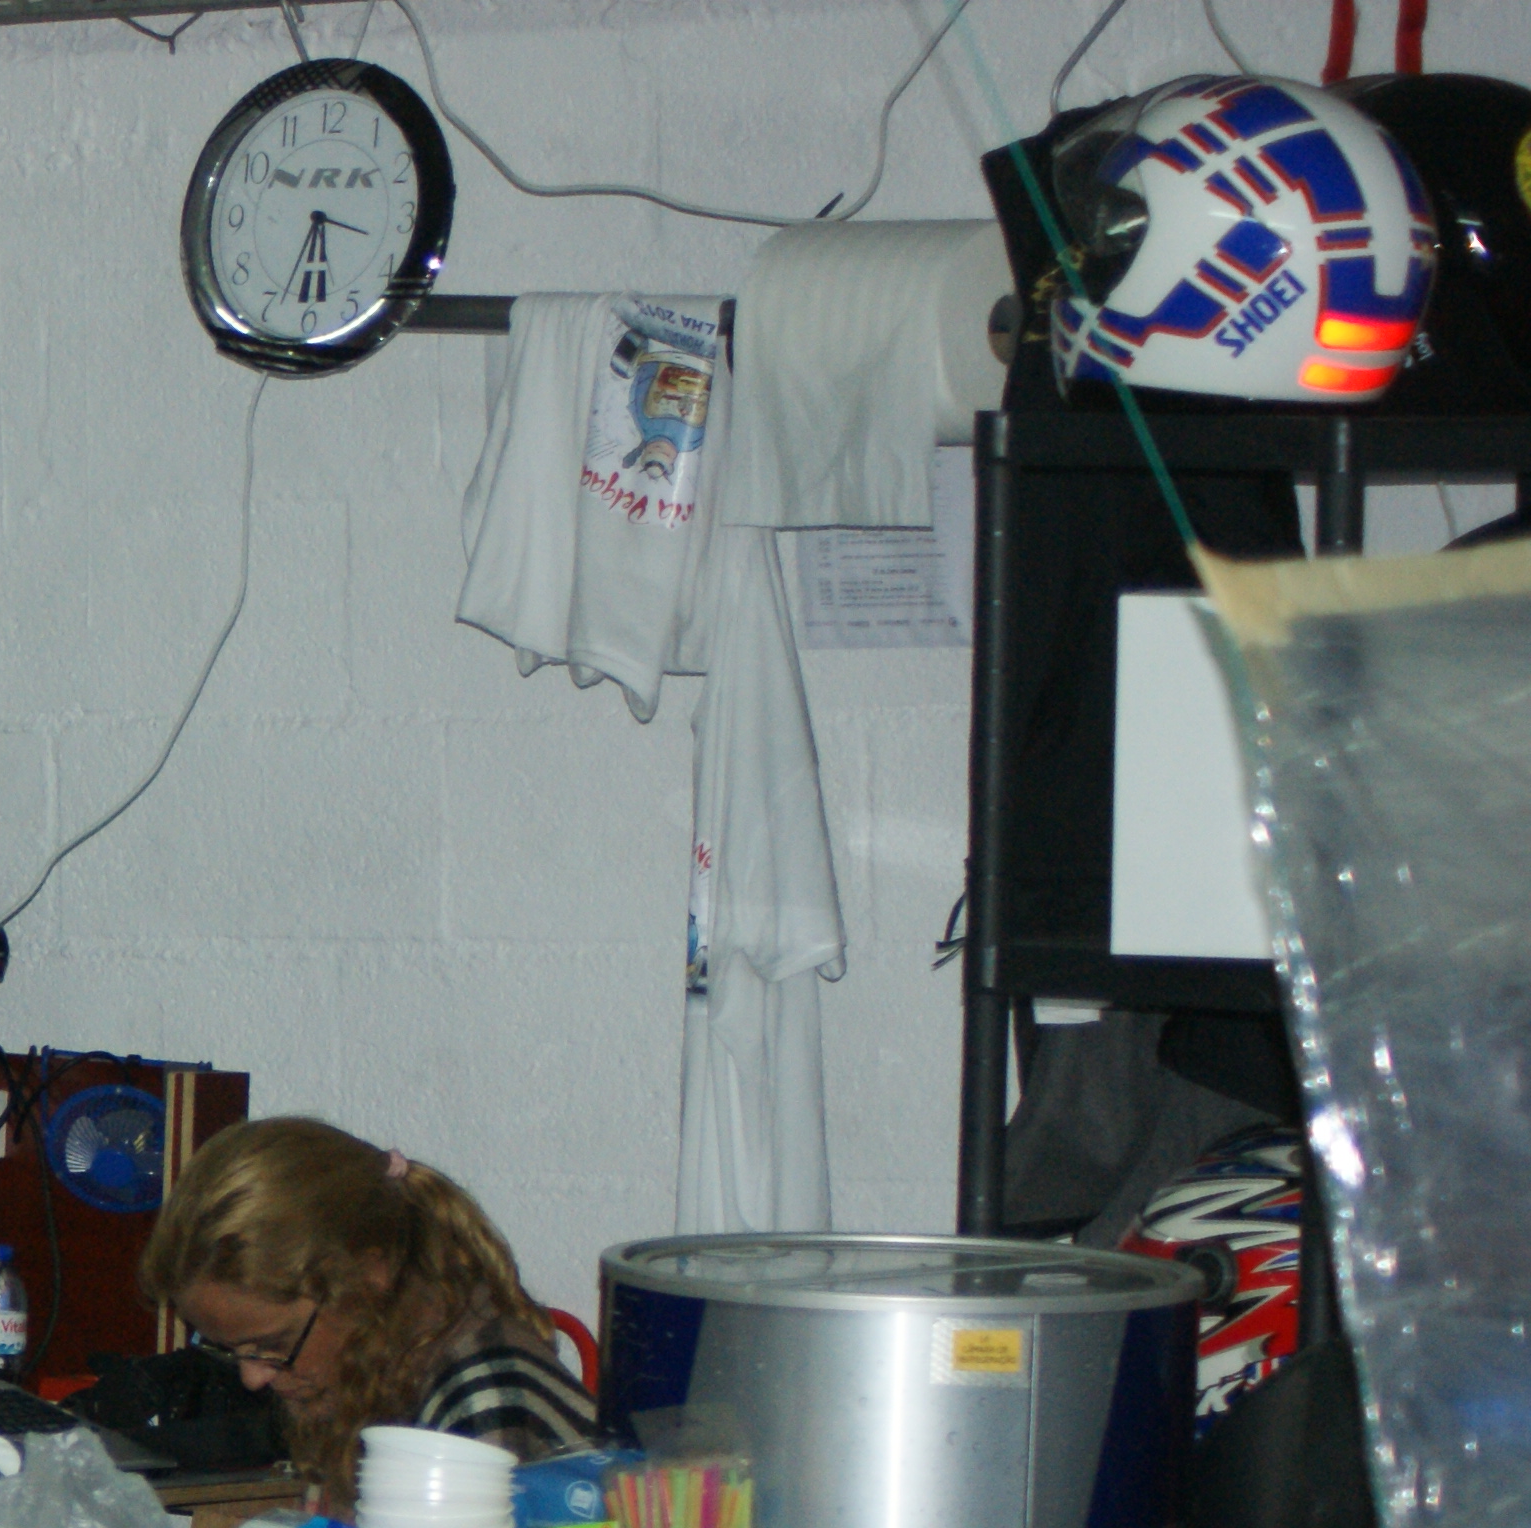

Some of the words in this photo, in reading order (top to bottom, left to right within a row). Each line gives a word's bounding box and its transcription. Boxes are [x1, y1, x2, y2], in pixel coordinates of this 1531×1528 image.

[282, 115, 297, 147] 11
[321, 101, 347, 133] 12
[372, 117, 380, 148] 1
[243, 151, 270, 184] 10
[268, 168, 381, 189] NRK
[393, 152, 412, 184] 2
[228, 204, 245, 236] 9
[396, 201, 416, 234] 3
[231, 252, 251, 285] 8
[378, 253, 395, 284] 4
[262, 291, 278, 323] 7
[301, 302, 317, 334] 6
[340, 290, 360, 322] 5
[1214, 269, 1307, 359] SHOEI
